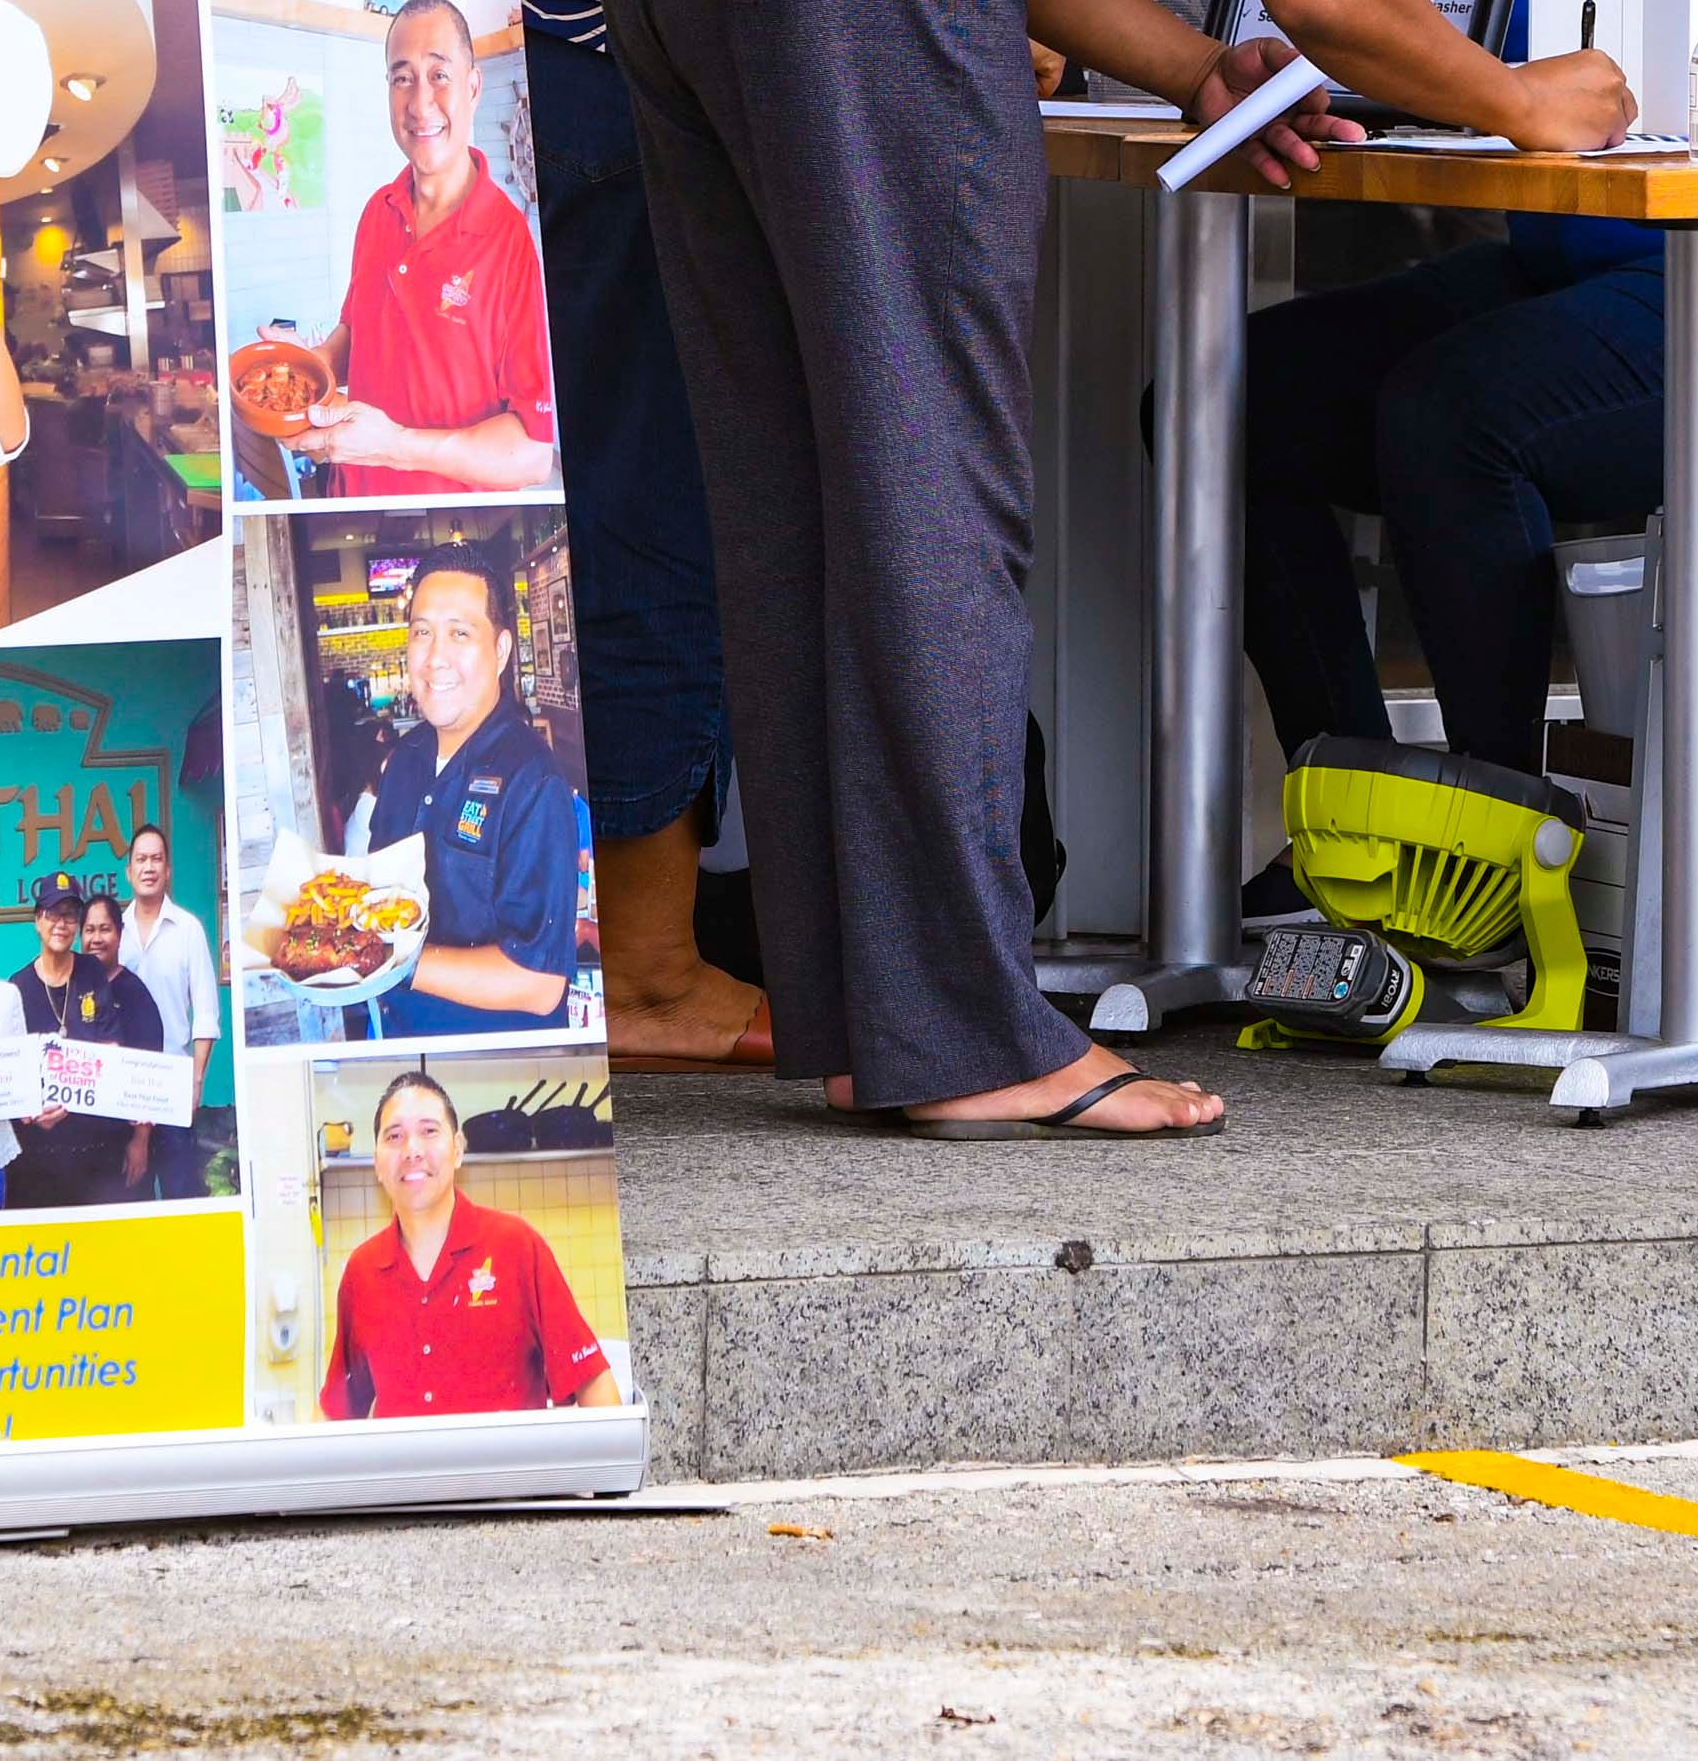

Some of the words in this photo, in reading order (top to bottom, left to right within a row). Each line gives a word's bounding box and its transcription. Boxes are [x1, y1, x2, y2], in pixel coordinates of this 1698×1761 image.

[46, 1048, 104, 1077] Best
[58, 1071, 97, 1088] Guam
[46, 1084, 96, 1107] 2016
[56, 1295, 134, 1331] Plan
